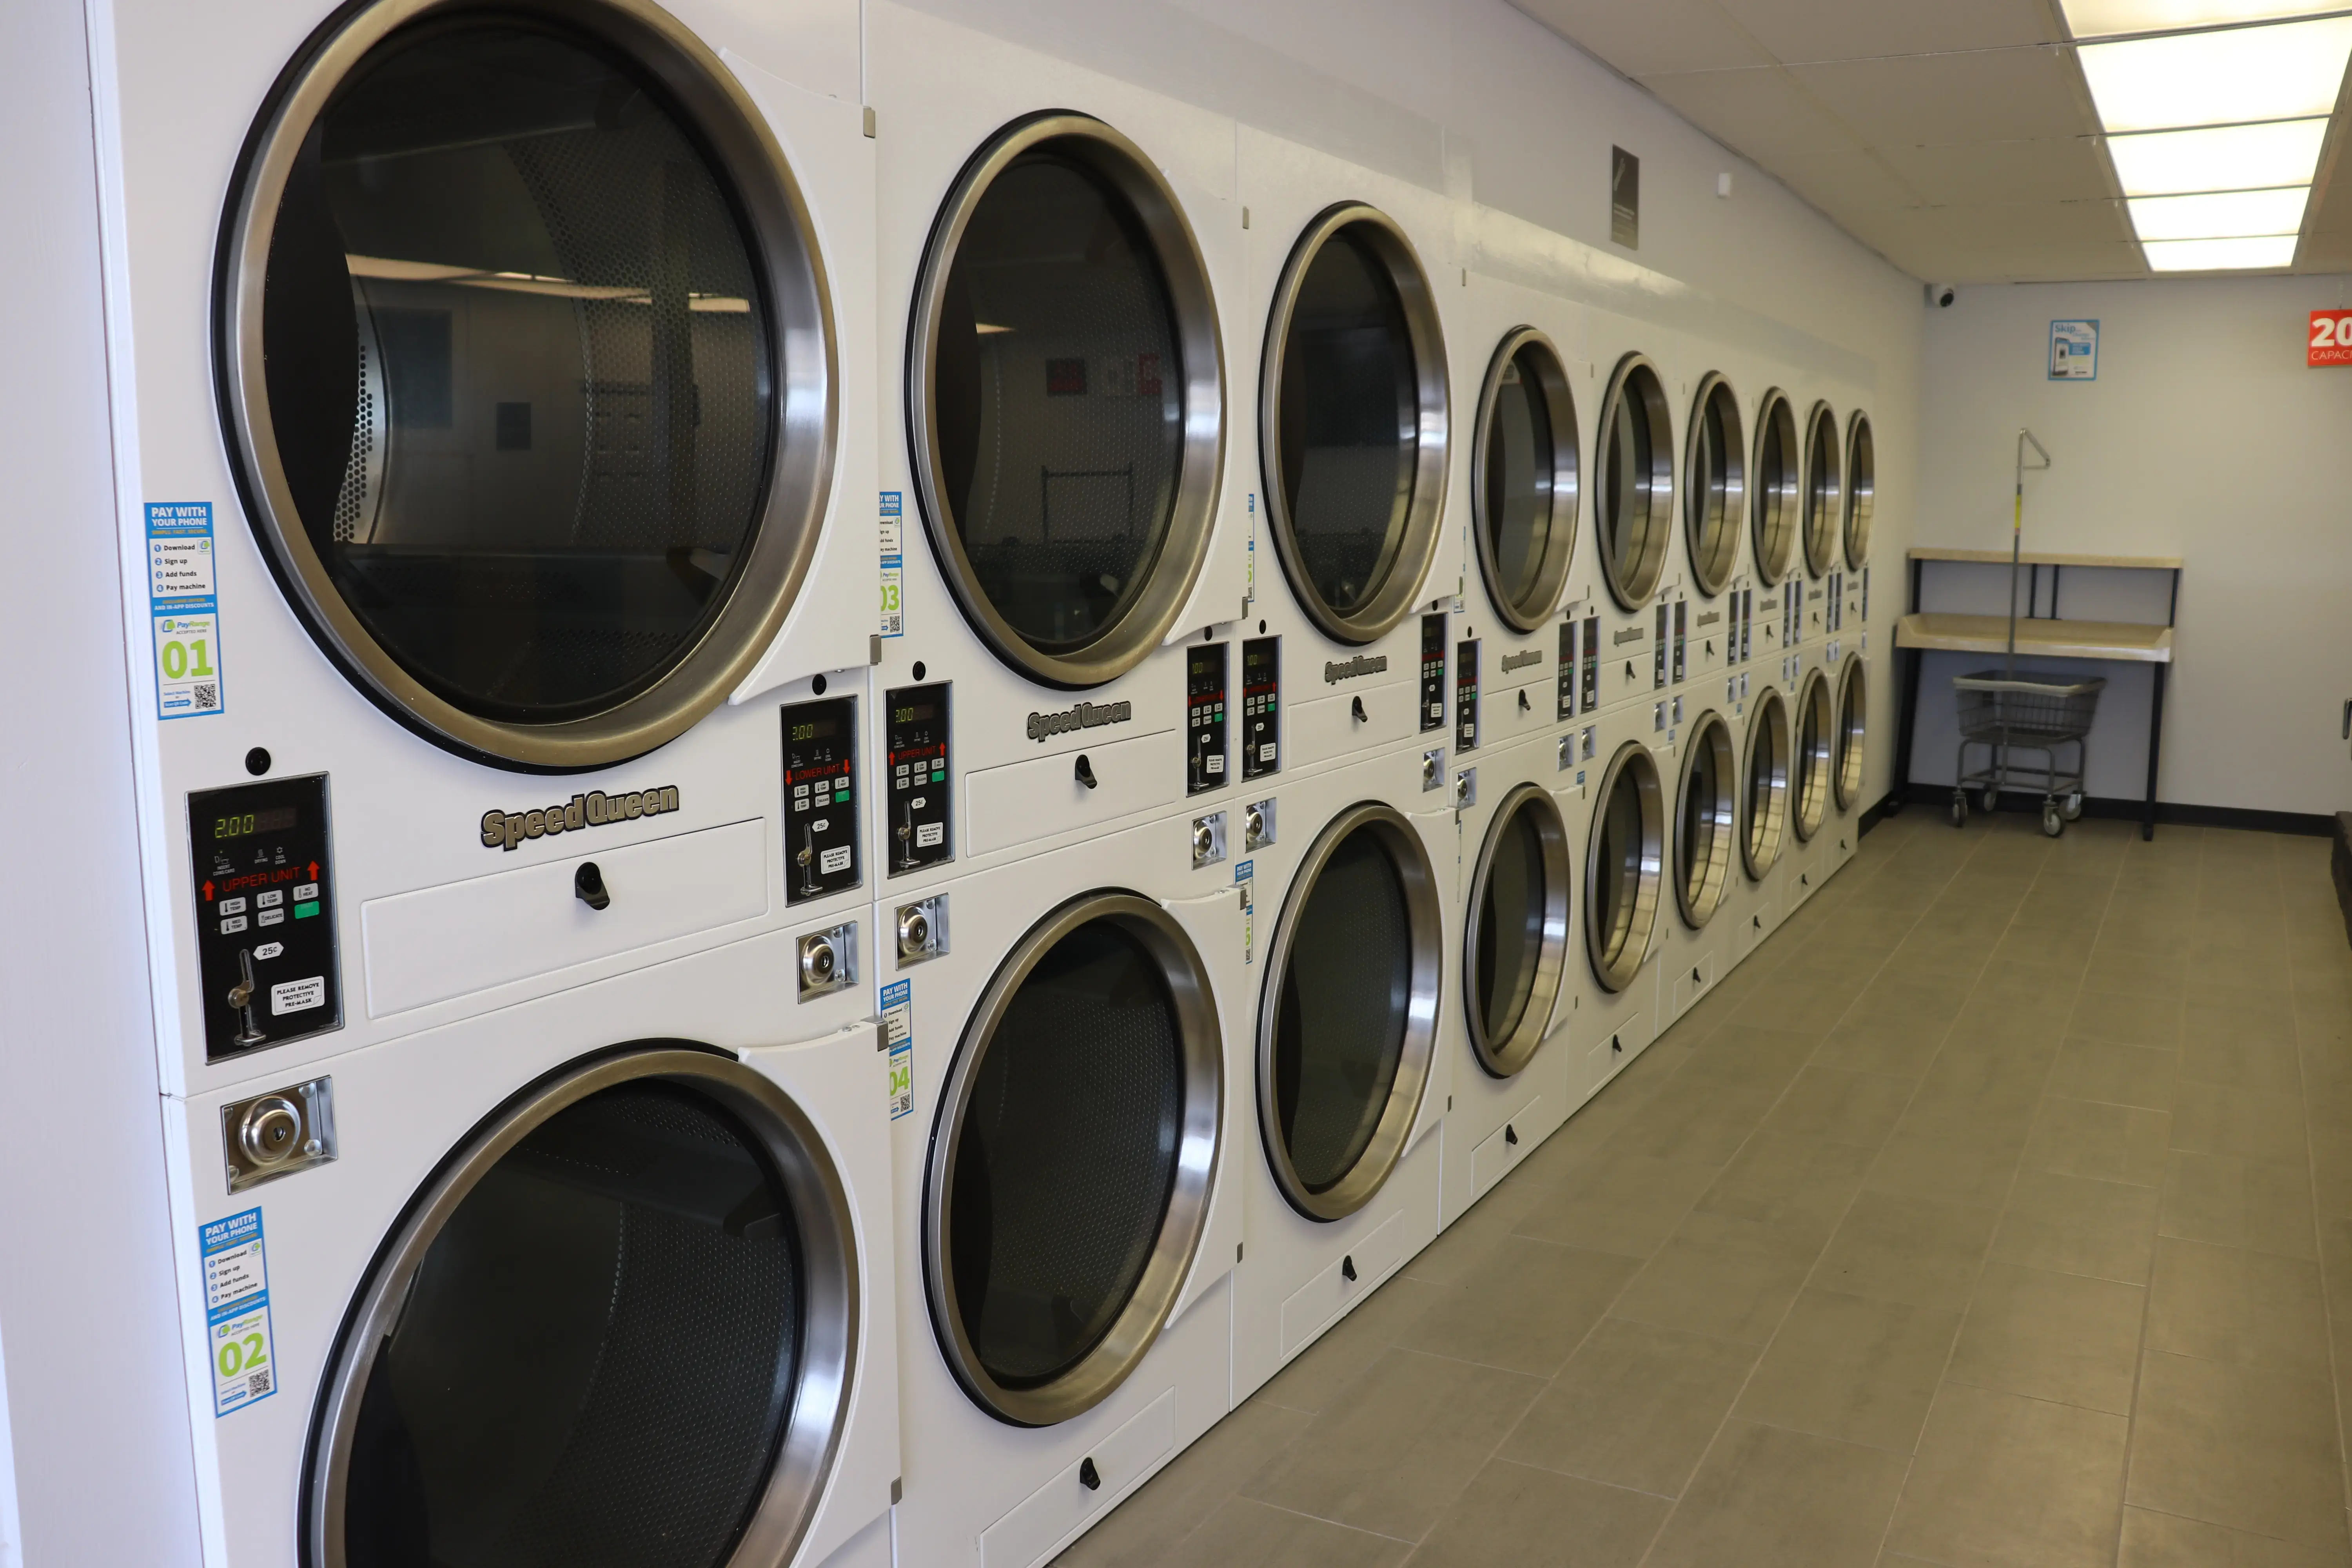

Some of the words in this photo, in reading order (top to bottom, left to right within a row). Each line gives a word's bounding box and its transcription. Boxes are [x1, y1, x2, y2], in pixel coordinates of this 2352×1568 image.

[2055, 323, 2076, 334] Skip
[151, 507, 173, 517] PAY
[175, 506, 206, 517] WITH
[178, 517, 207, 526] PHONE
[177, 621, 210, 630] PayRange
[162, 639, 213, 679] 01
[922, 746, 936, 756] UNIT
[795, 768, 822, 780] LOWER
[824, 764, 840, 775] UNIT
[215, 814, 254, 838] 2.00
[223, 873, 268, 892] UPPER
[271, 866, 301, 882] UNIT
[277, 987, 296, 995] PLEASE
[298, 982, 319, 991] REMOVE
[883, 987, 893, 996] PAY
[894, 982, 908, 993] WITH
[282, 991, 314, 1001] PROTECTIVE
[883, 993, 895, 1002] YOUR
[895, 989, 908, 998] PHONE
[285, 998, 312, 1007] PRE-MASK
[888, 1007, 902, 1016] Download
[205, 1222, 227, 1238] PAY
[227, 1212, 256, 1229] WITH
[206, 1232, 230, 1245] YOUR
[230, 1222, 258, 1237] PHONE
[218, 1250, 247, 1264] Download
[220, 1280, 231, 1288] Add
[233, 1274, 249, 1283] funds
[233, 1283, 258, 1295] machine
[218, 1332, 267, 1377] 02
